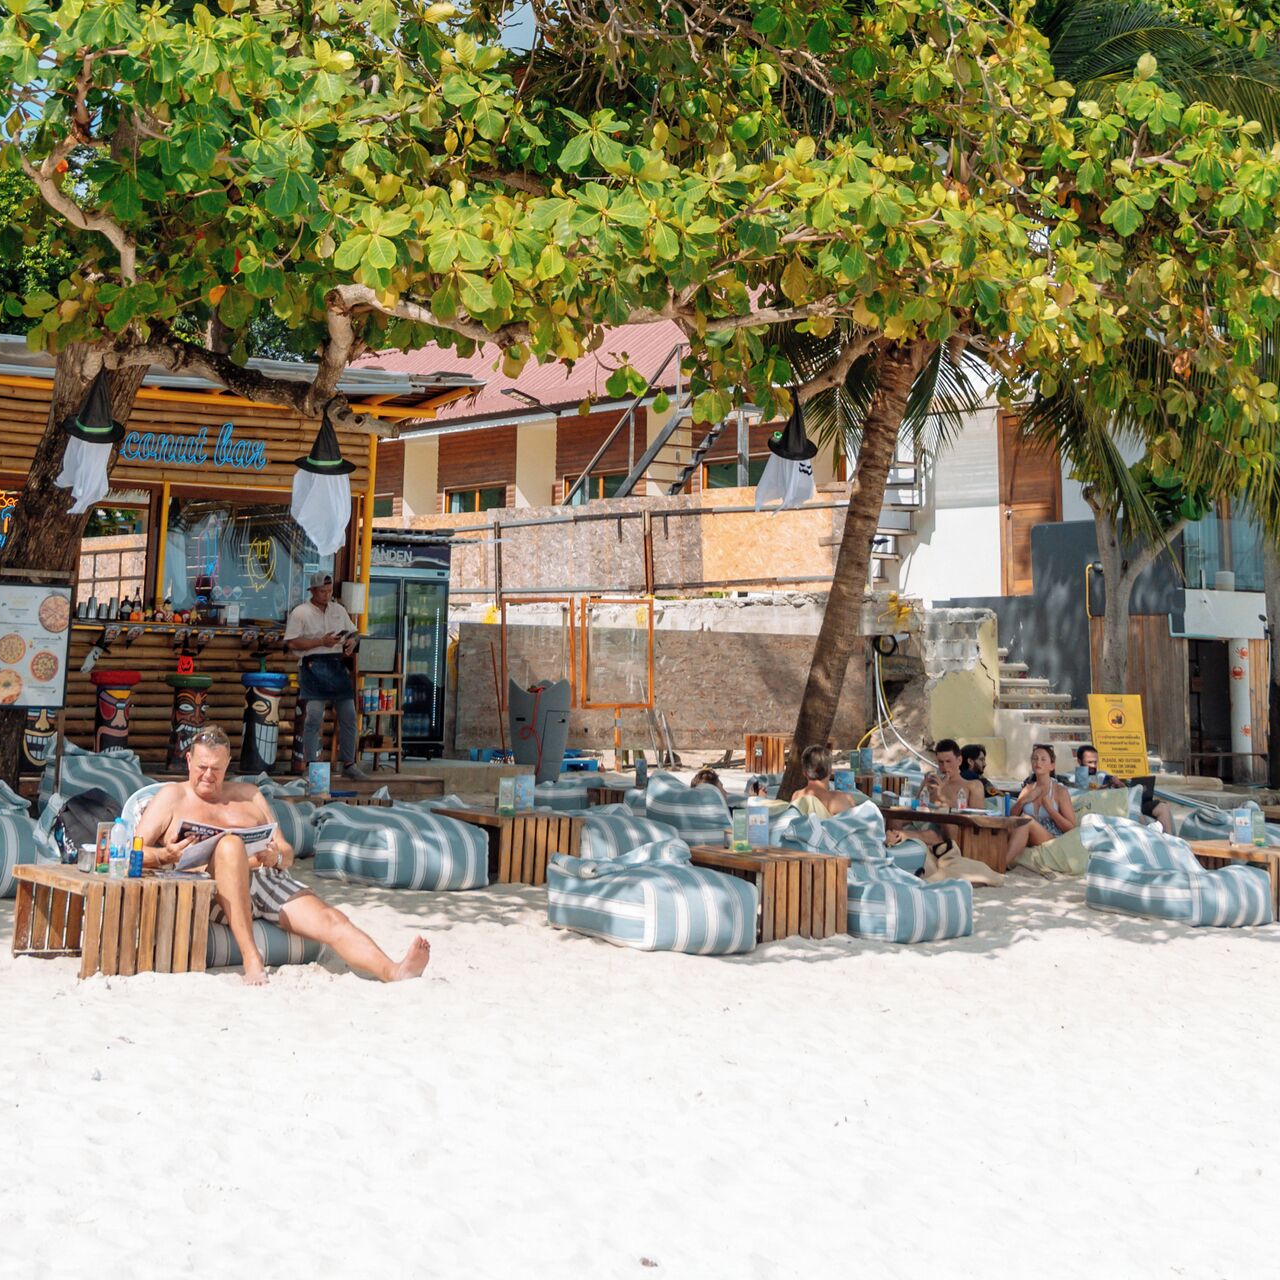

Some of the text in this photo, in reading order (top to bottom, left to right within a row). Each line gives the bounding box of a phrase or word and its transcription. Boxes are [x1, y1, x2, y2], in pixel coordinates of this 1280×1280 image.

[120, 422, 267, 470] conut bar
[371, 547, 413, 562] ANDEN
